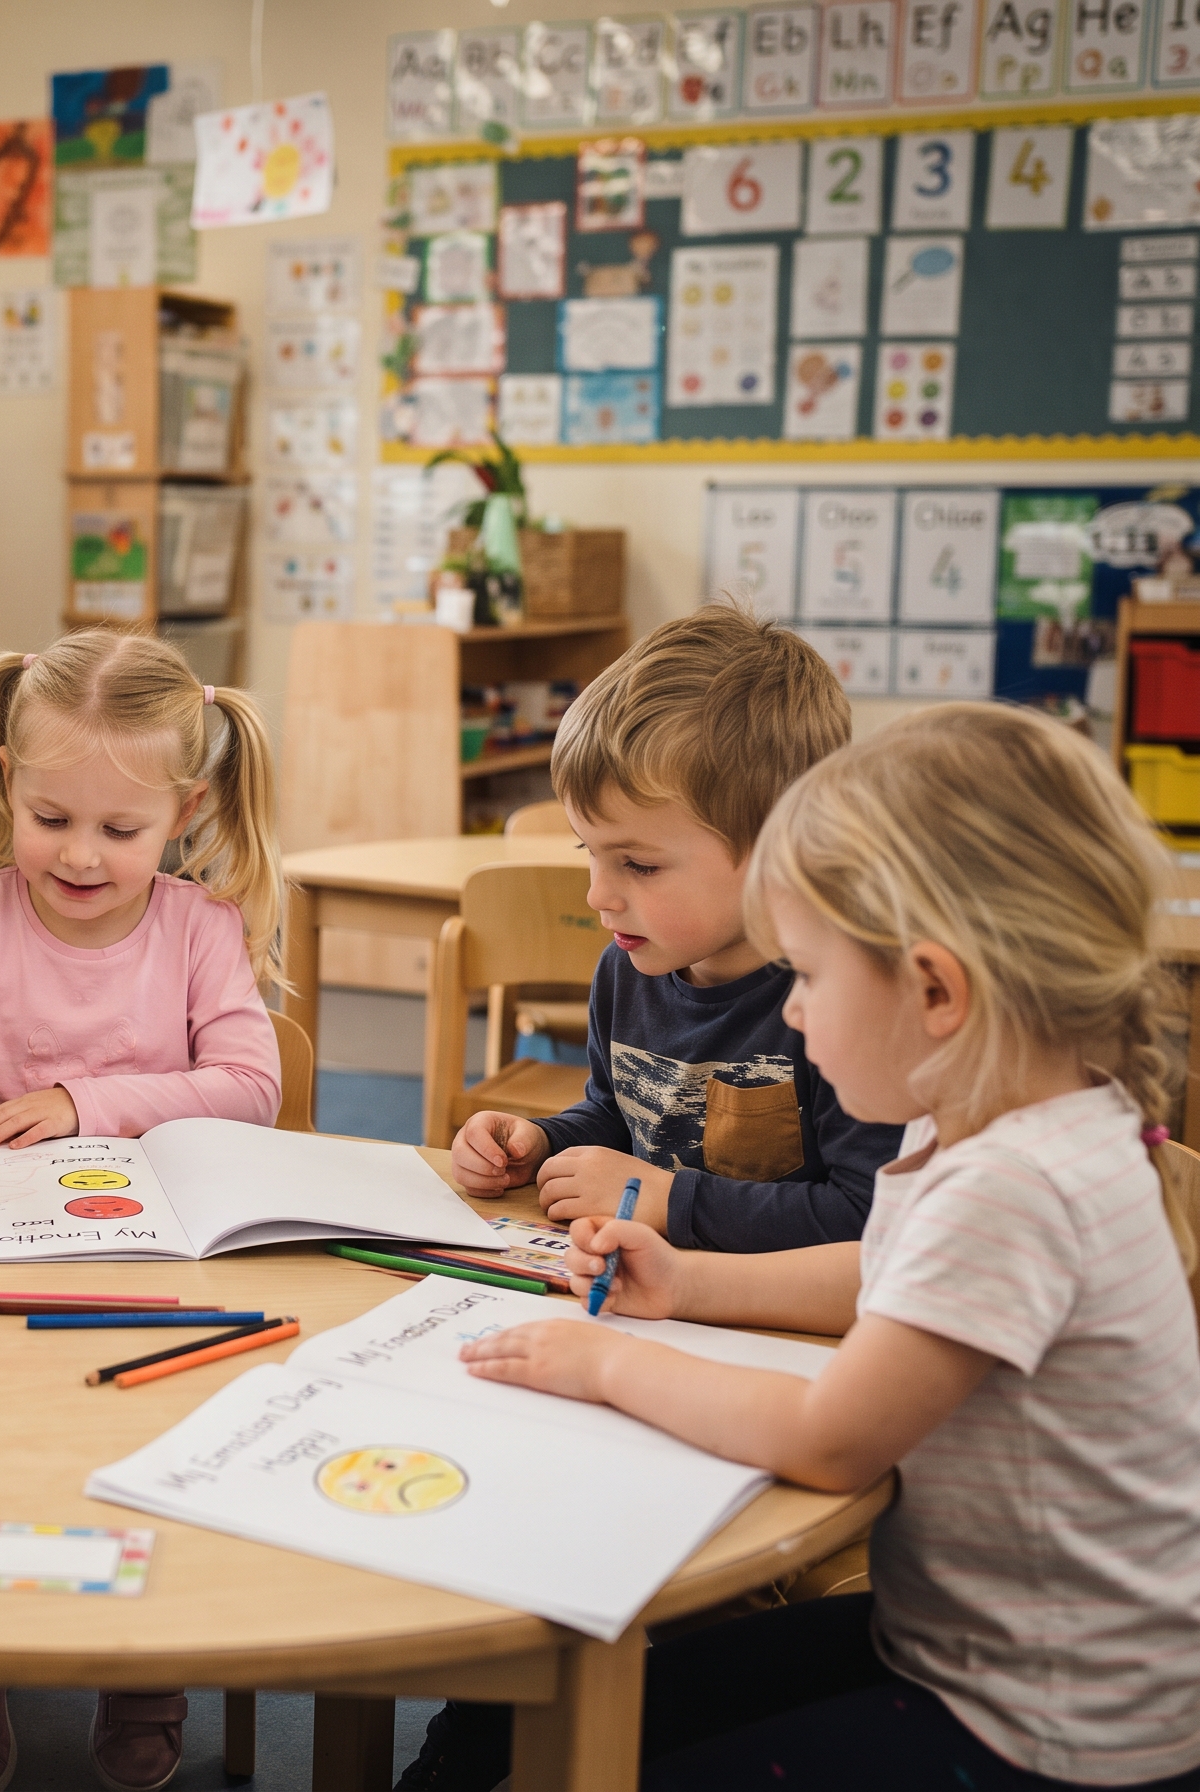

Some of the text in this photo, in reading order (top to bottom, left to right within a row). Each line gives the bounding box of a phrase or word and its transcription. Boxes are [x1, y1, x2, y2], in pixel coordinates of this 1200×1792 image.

[725, 156, 763, 213] 6
[826, 147, 864, 203] 2
[913, 141, 952, 199] 3
[1008, 138, 1053, 198] 4
[930, 543, 965, 597] 4
[115, 1227, 157, 1240] My
[430, 1292, 498, 1316] Diary
